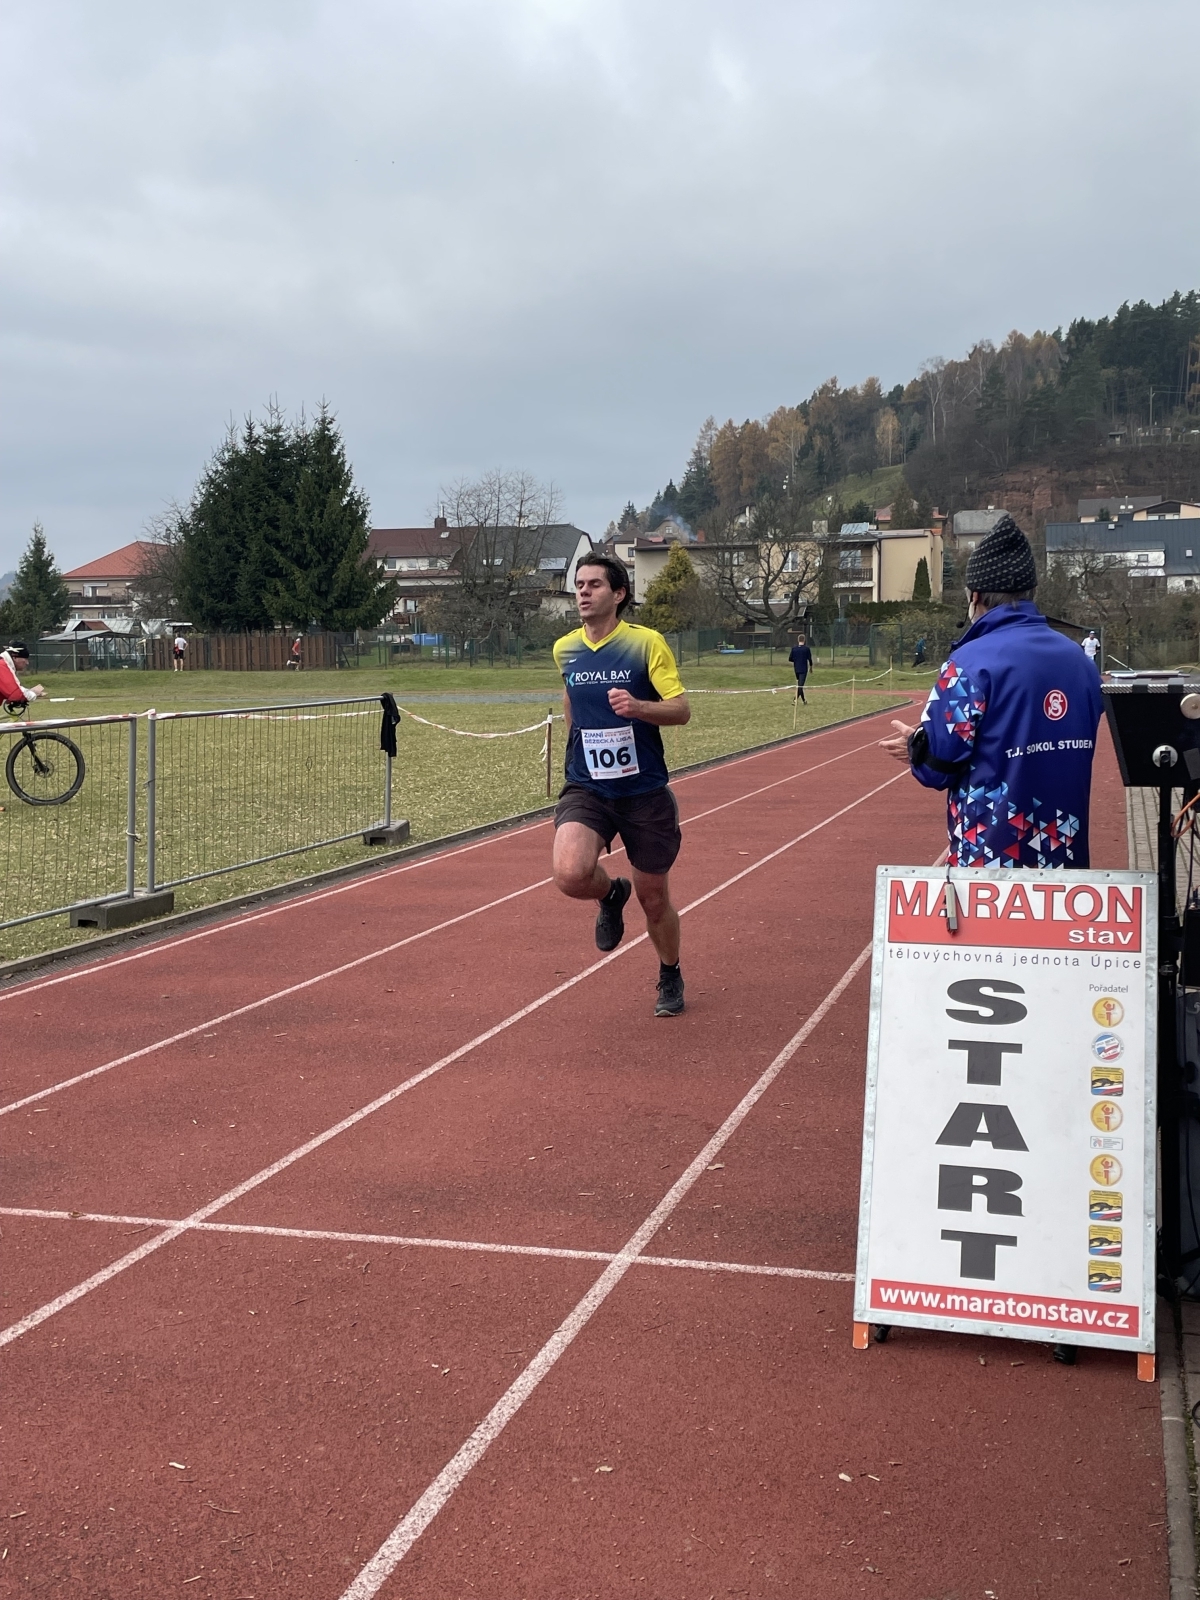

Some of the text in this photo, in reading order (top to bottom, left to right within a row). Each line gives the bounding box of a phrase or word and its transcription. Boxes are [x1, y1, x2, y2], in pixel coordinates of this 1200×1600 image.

[575, 669, 632, 682] ROYAL BAY
[588, 746, 632, 769] 106
[1005, 746, 1024, 759] T.J.
[1026, 741, 1056, 755] SOKOL
[889, 879, 1143, 925] MARATON
[1068, 926, 1134, 945] stav
[888, 948, 1143, 970] tělovýchovná jednota Úpice
[1088, 983, 1129, 993] Pořadatel
[935, 978, 1030, 1281] START
[879, 1287, 1130, 1329] www.maratonstav.cz
